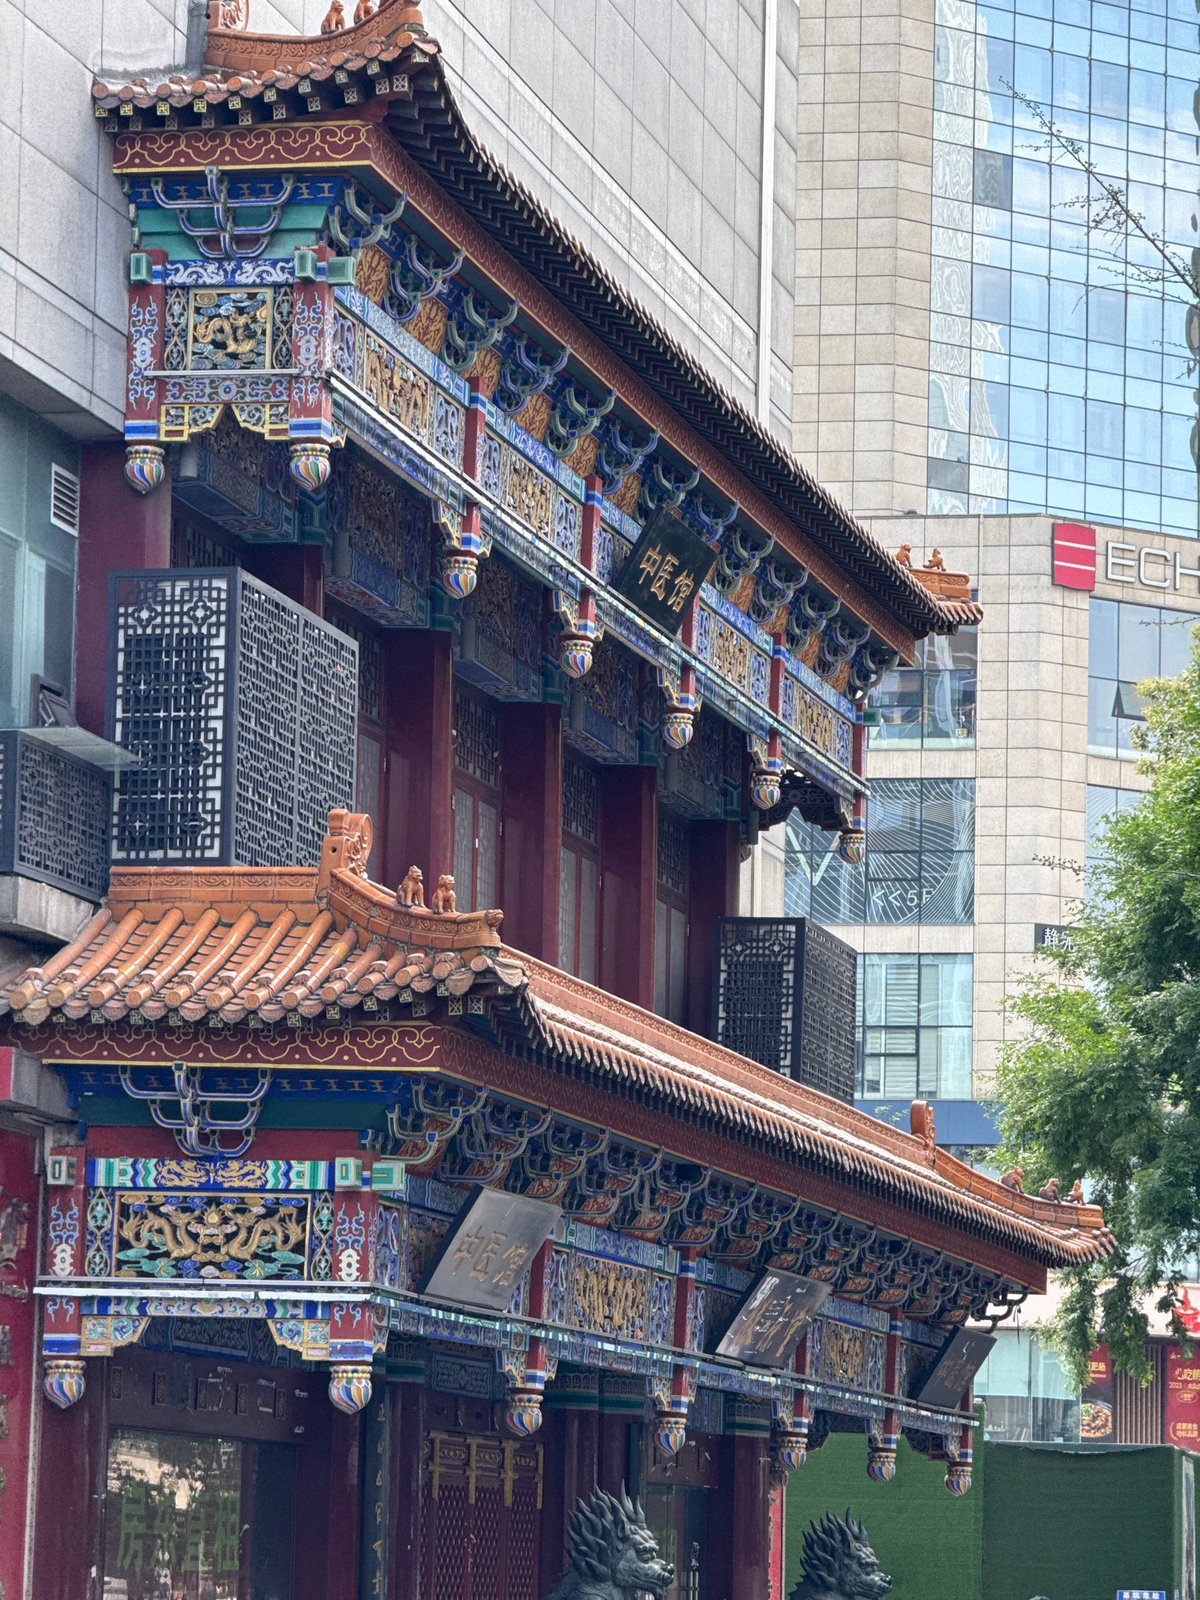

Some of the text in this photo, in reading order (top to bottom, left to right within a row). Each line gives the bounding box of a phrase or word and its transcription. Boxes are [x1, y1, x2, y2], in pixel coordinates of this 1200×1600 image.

[639, 543, 694, 613] 中医馆
[1106, 540, 1200, 590] ECH
[452, 1225, 529, 1287] 中医馆
